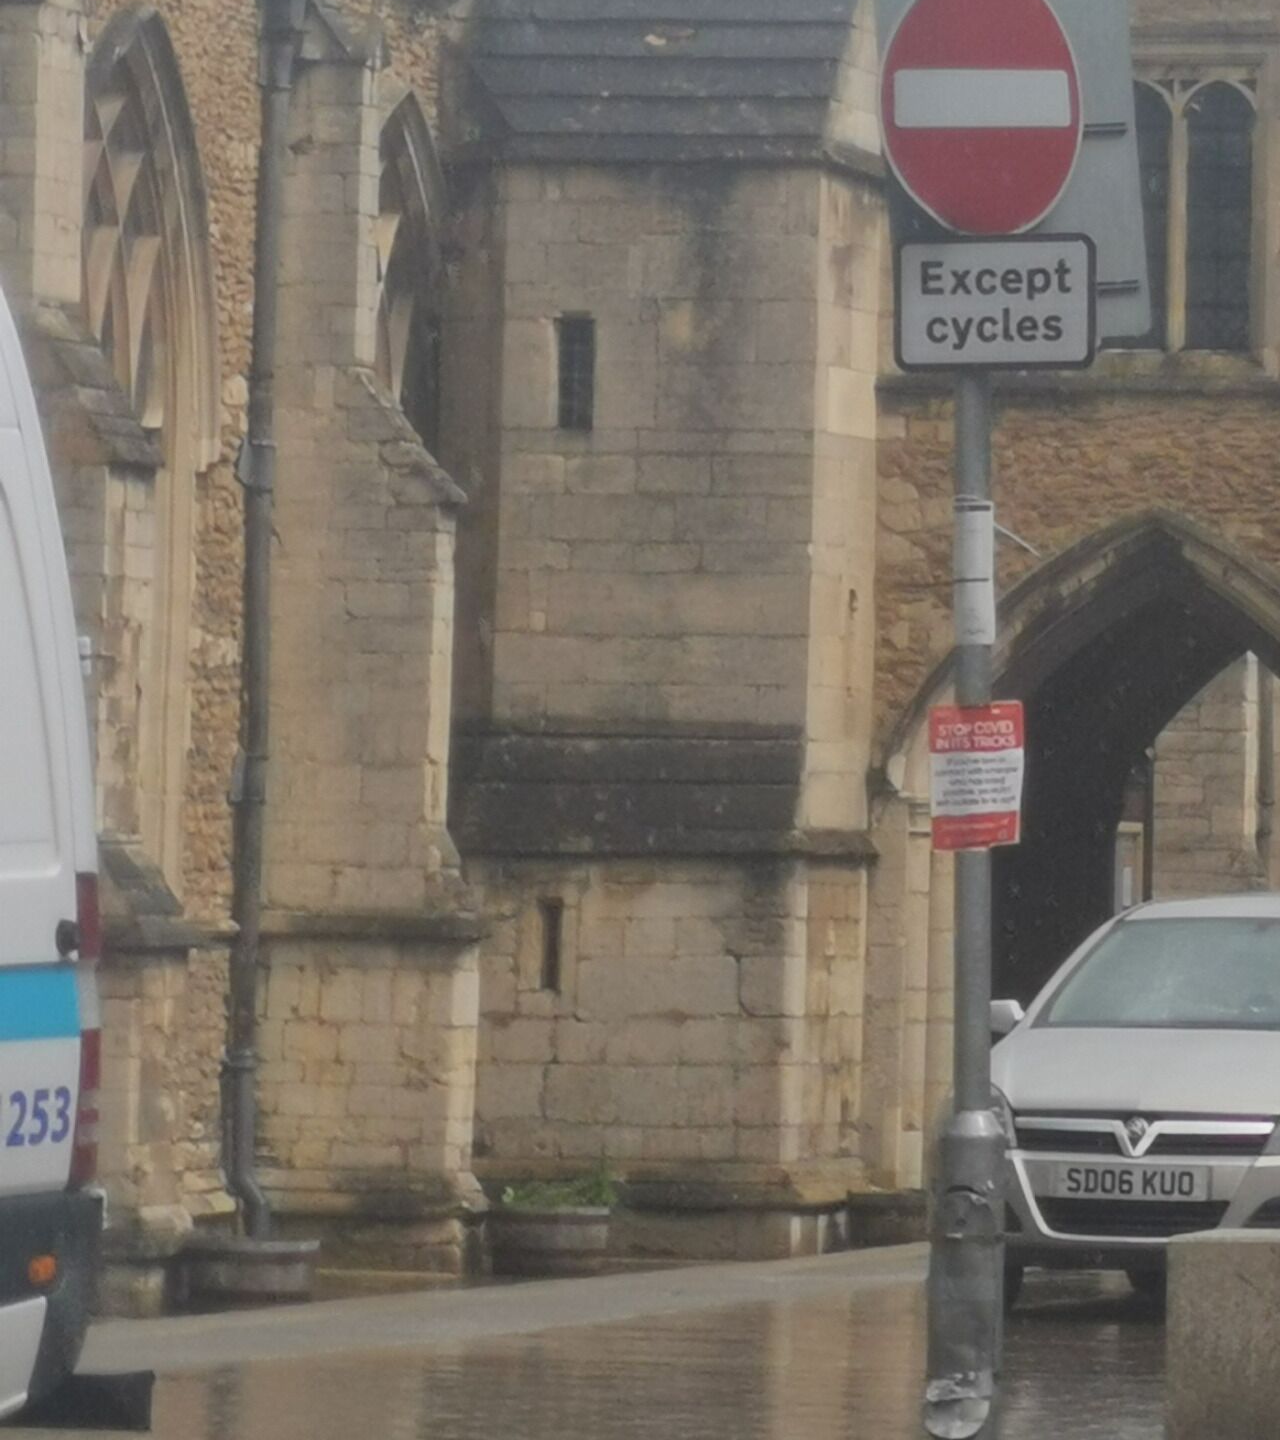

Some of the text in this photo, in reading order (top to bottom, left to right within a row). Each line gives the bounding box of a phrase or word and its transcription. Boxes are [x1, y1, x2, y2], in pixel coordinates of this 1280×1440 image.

[920, 259, 1072, 300] Except
[926, 308, 1062, 350] cycles
[1066, 1167, 1195, 1196] SD06 KUO
